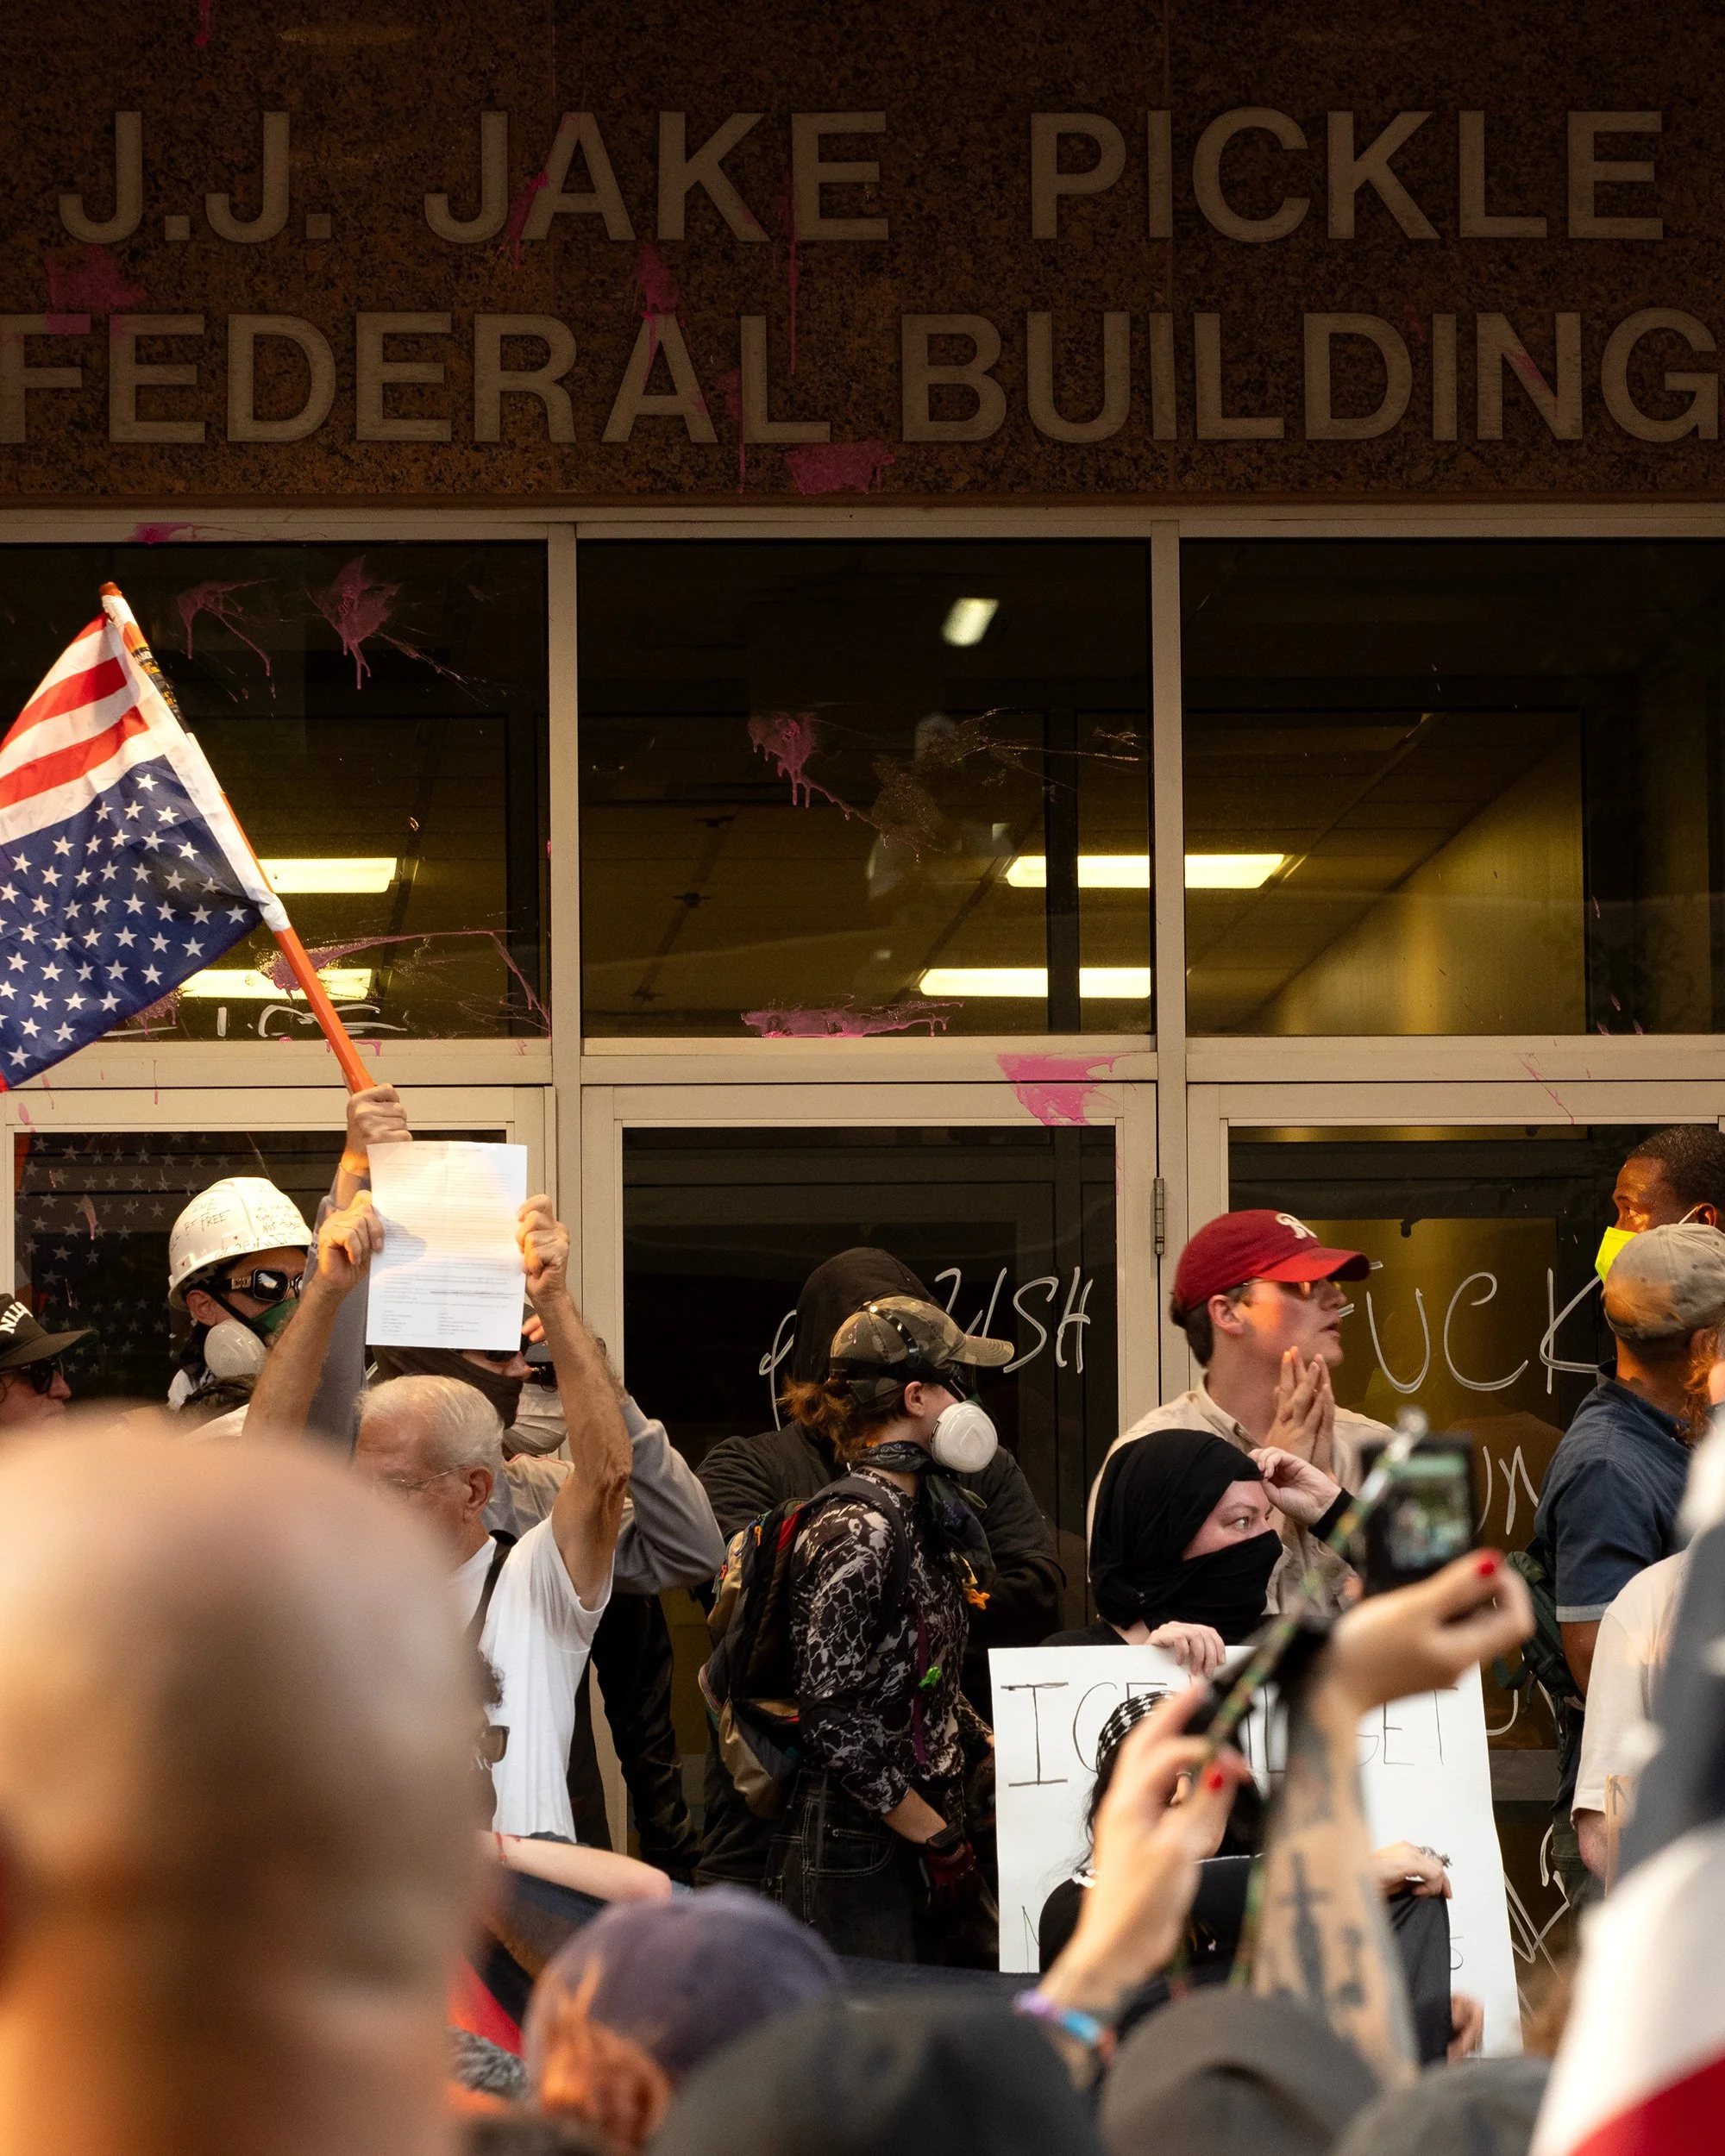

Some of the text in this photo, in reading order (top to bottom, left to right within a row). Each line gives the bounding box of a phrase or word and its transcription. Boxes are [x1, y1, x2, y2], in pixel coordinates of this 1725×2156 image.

[59, 106, 1665, 244] J.J. JAKE PICKLE
[0, 308, 1721, 444] FEDERAL BUILDING
[200, 1209, 231, 1232] FREE
[1338, 1260, 1605, 1394] UCK
